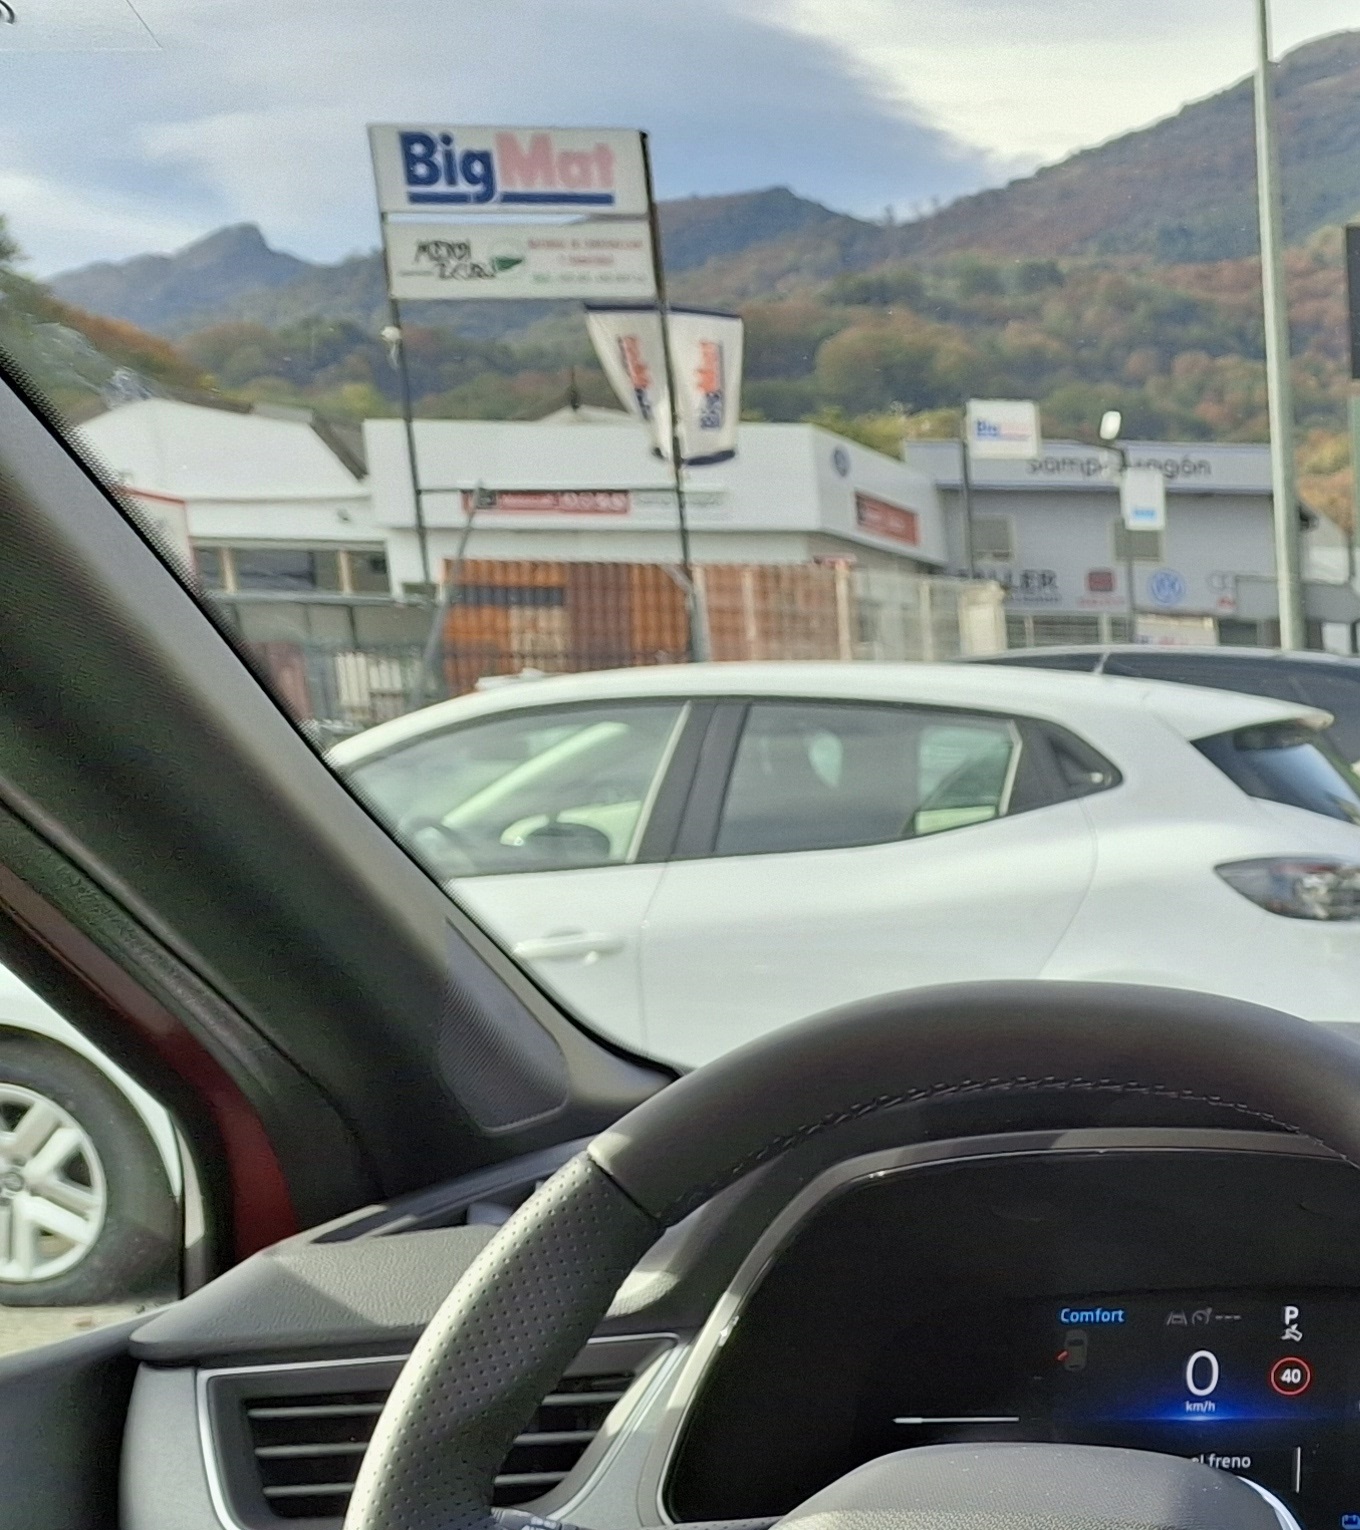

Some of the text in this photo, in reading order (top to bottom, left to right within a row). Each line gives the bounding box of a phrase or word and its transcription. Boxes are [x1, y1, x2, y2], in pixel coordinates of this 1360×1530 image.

[399, 130, 617, 204] BigMat
[1060, 1306, 1299, 1325] Comfort P
[1185, 1350, 1219, 1397] 0
[1279, 1368, 1301, 1384] 40
[1185, 1400, 1216, 1414] km/h
[1208, 1453, 1251, 1469] freno
